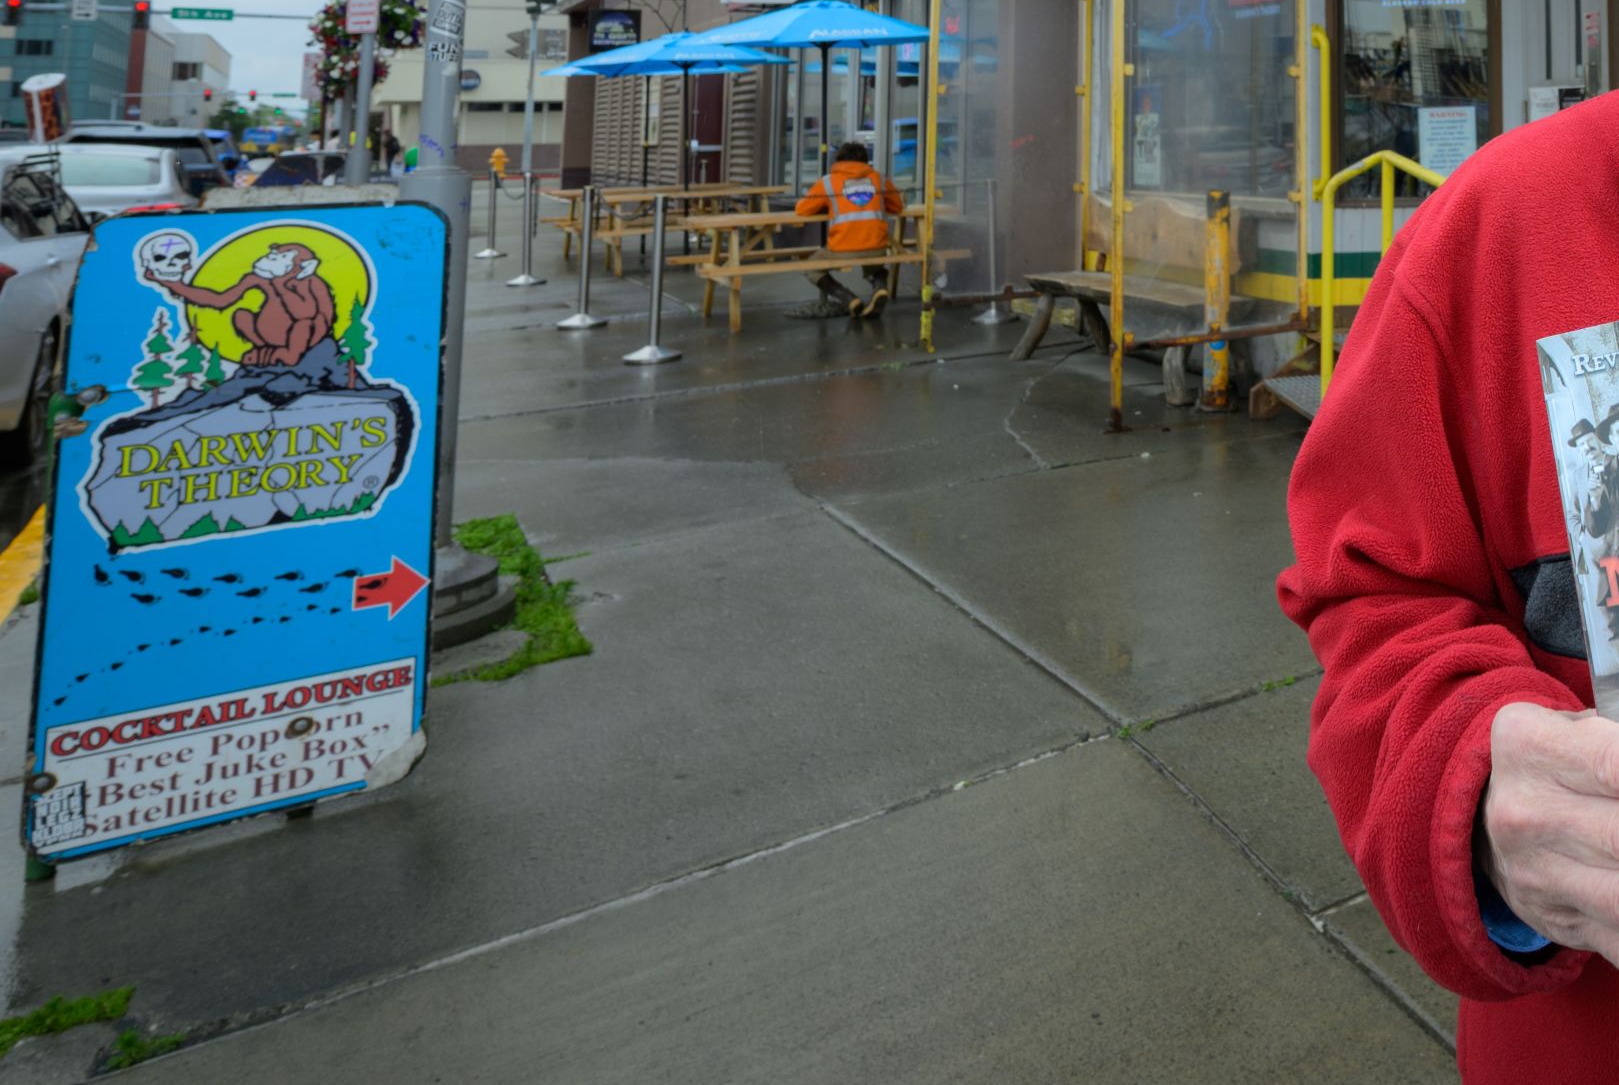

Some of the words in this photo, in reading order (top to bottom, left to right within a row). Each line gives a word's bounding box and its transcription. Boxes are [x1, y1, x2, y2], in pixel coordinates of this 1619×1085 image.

[116, 417, 388, 478] DARWIN'S
[139, 454, 364, 510] THEORY
[50, 698, 256, 757] COCKTAIL
[263, 665, 414, 713] LOUNGE
[105, 747, 194, 780] Free
[210, 711, 363, 757] Poporn
[194, 750, 286, 785] Juke
[251, 765, 313, 799] HD
